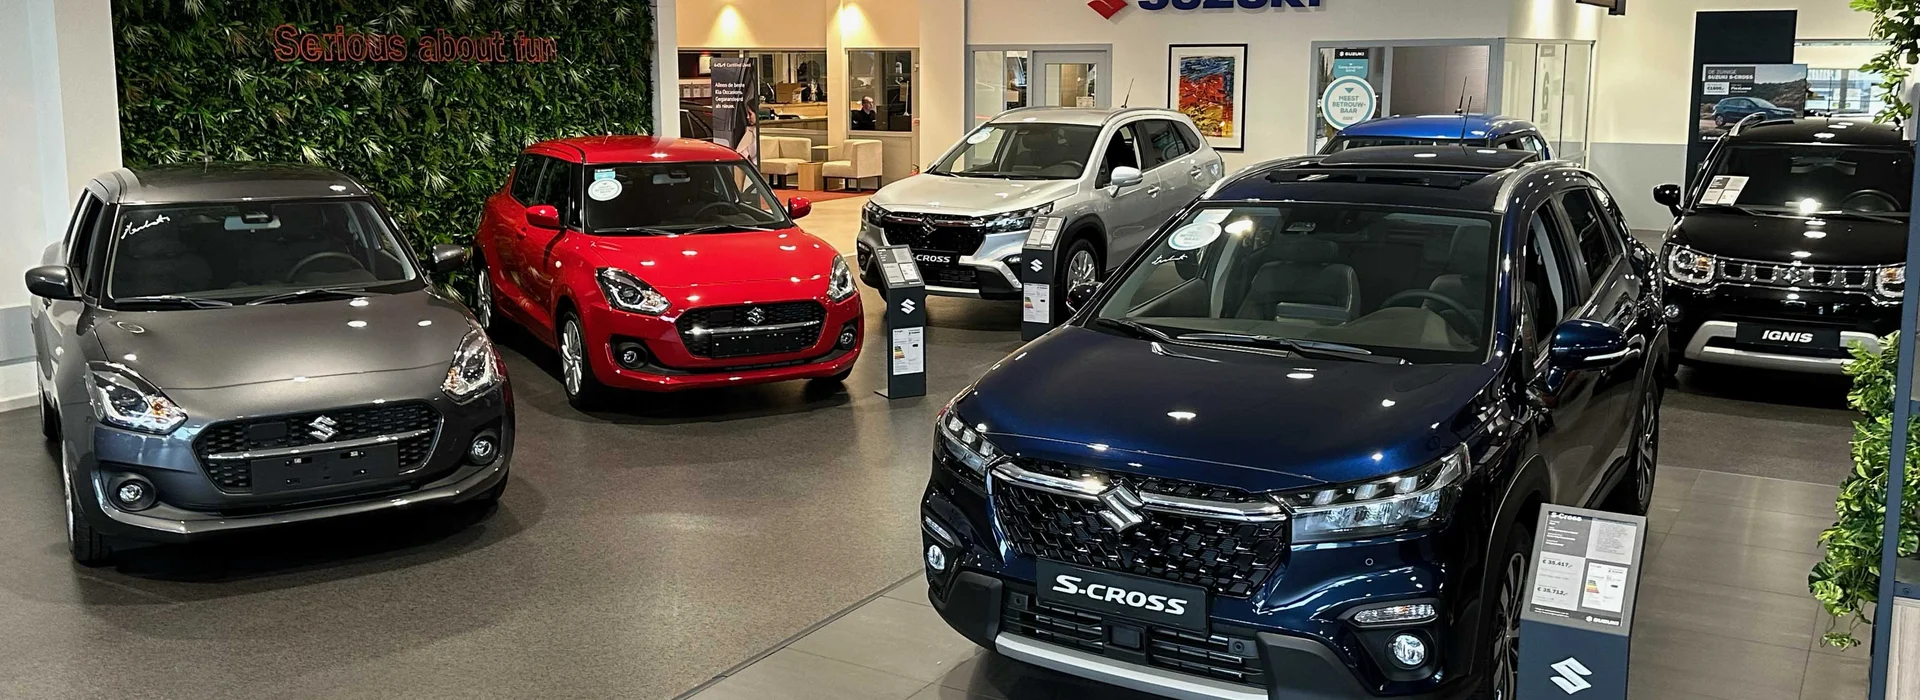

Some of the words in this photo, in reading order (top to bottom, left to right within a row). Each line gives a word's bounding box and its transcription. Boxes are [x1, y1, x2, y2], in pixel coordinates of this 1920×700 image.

[274, 24, 408, 62] Serious
[418, 28, 506, 62] about
[513, 30, 558, 62] fun
[1761, 329, 1814, 343] IGNIS
[1550, 512, 1582, 522] S-Cross
[1052, 574, 1188, 615] S-CROSS
